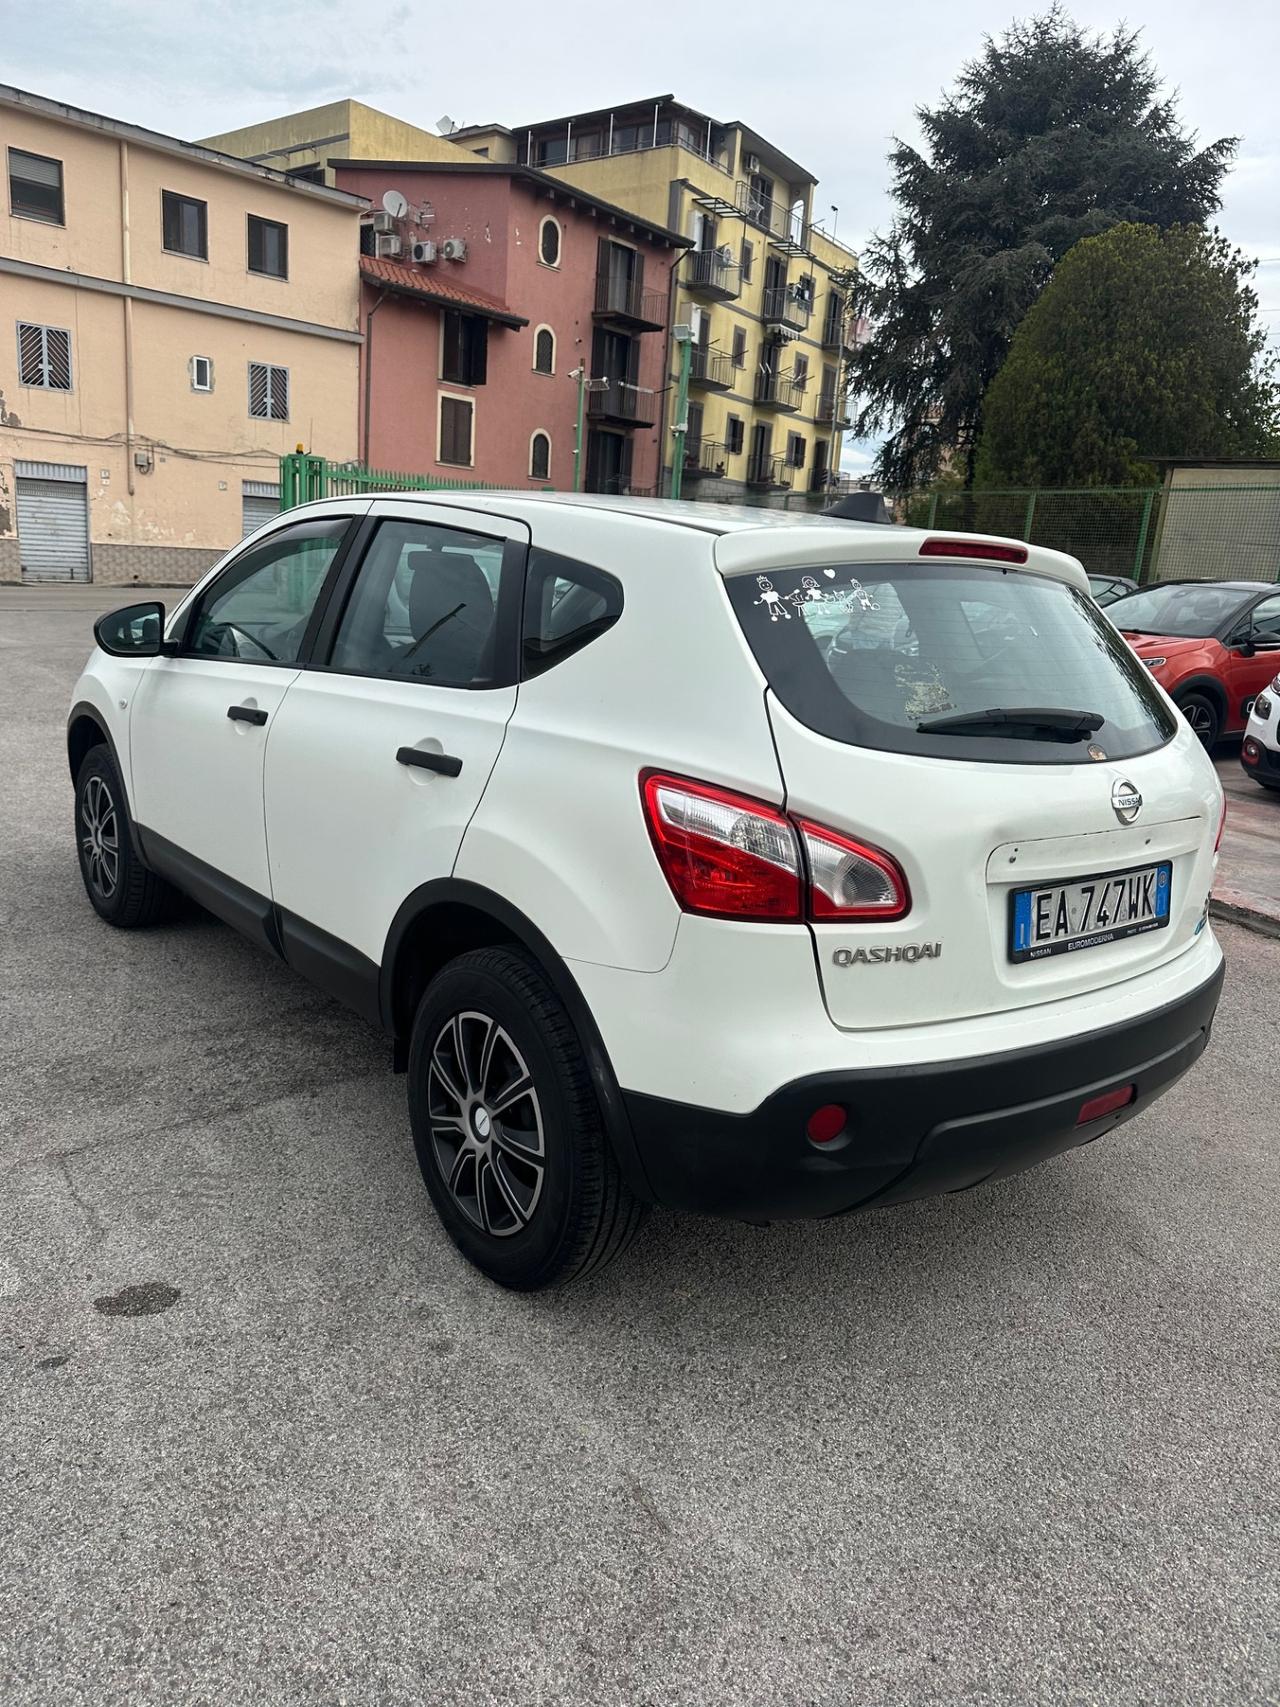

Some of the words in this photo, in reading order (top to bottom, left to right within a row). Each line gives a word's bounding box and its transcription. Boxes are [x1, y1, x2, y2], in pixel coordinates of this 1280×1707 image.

[1036, 889, 1068, 940] EA
[1081, 872, 1155, 932] 747WK
[1030, 948, 1052, 958] NISSAN
[1067, 933, 1114, 951] EUROMODERNA
[832, 941, 942, 967] QASHQAI
